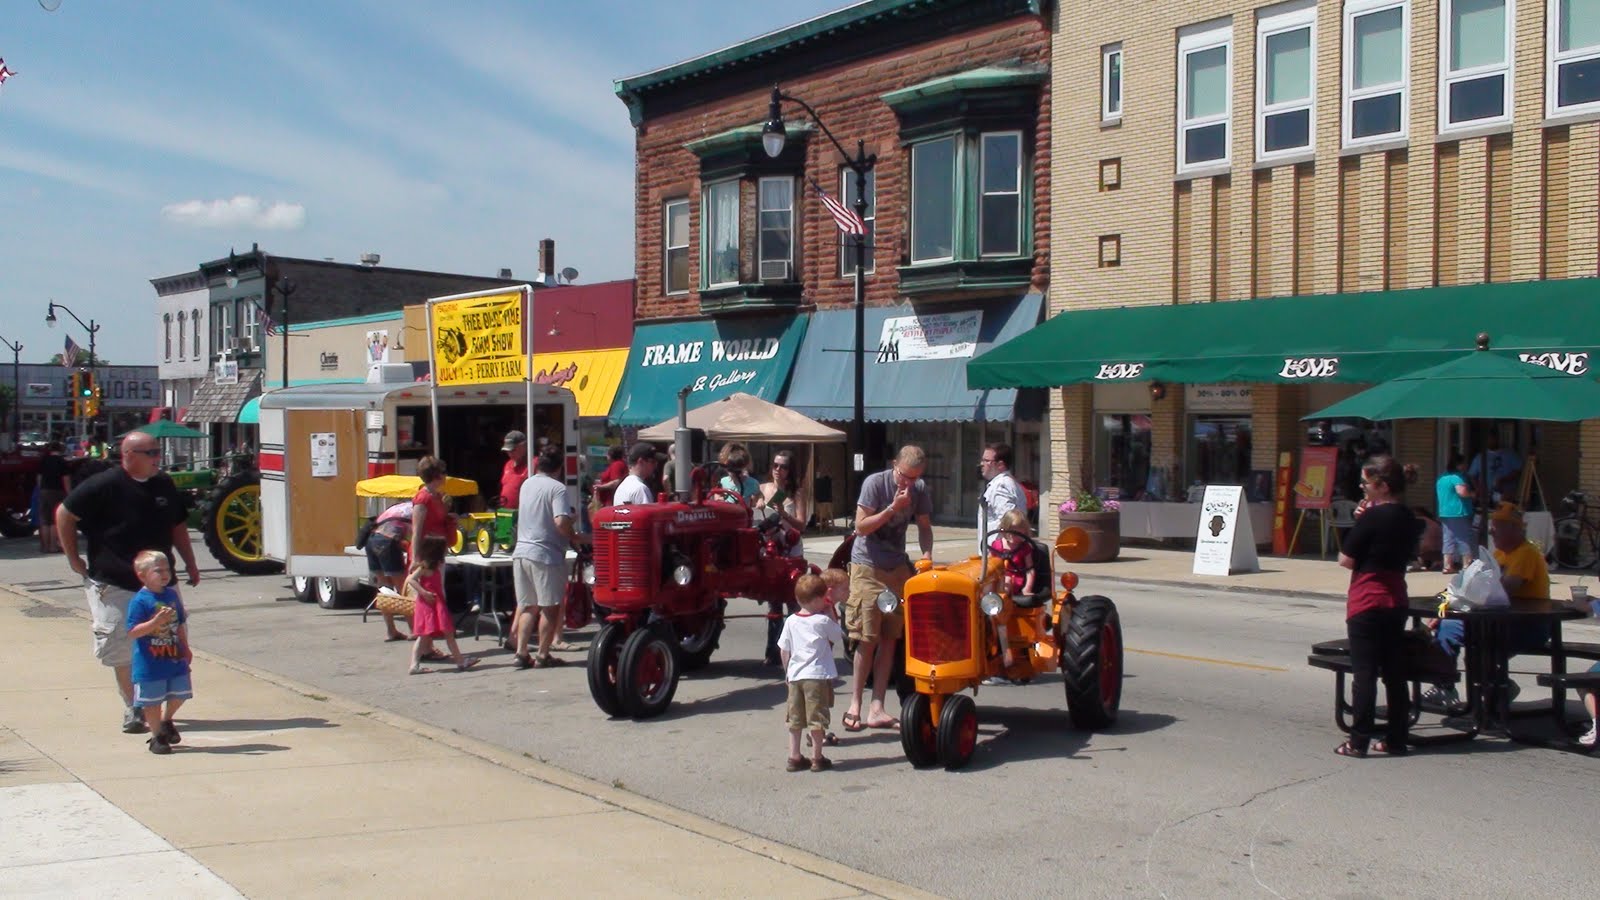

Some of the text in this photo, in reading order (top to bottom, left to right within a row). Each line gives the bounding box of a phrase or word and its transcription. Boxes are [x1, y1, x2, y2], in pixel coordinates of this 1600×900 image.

[503, 307, 520, 327] TIME
[470, 332, 514, 354] FARM SHOW
[641, 337, 779, 367] FRAME WORLD
[440, 367, 458, 382] JULY
[476, 362, 500, 379] PERRY
[500, 360, 522, 378] FARM
[1094, 362, 1144, 380] LOVE
[1278, 357, 1339, 379] LOVE
[692, 369, 757, 392] & Gallery
